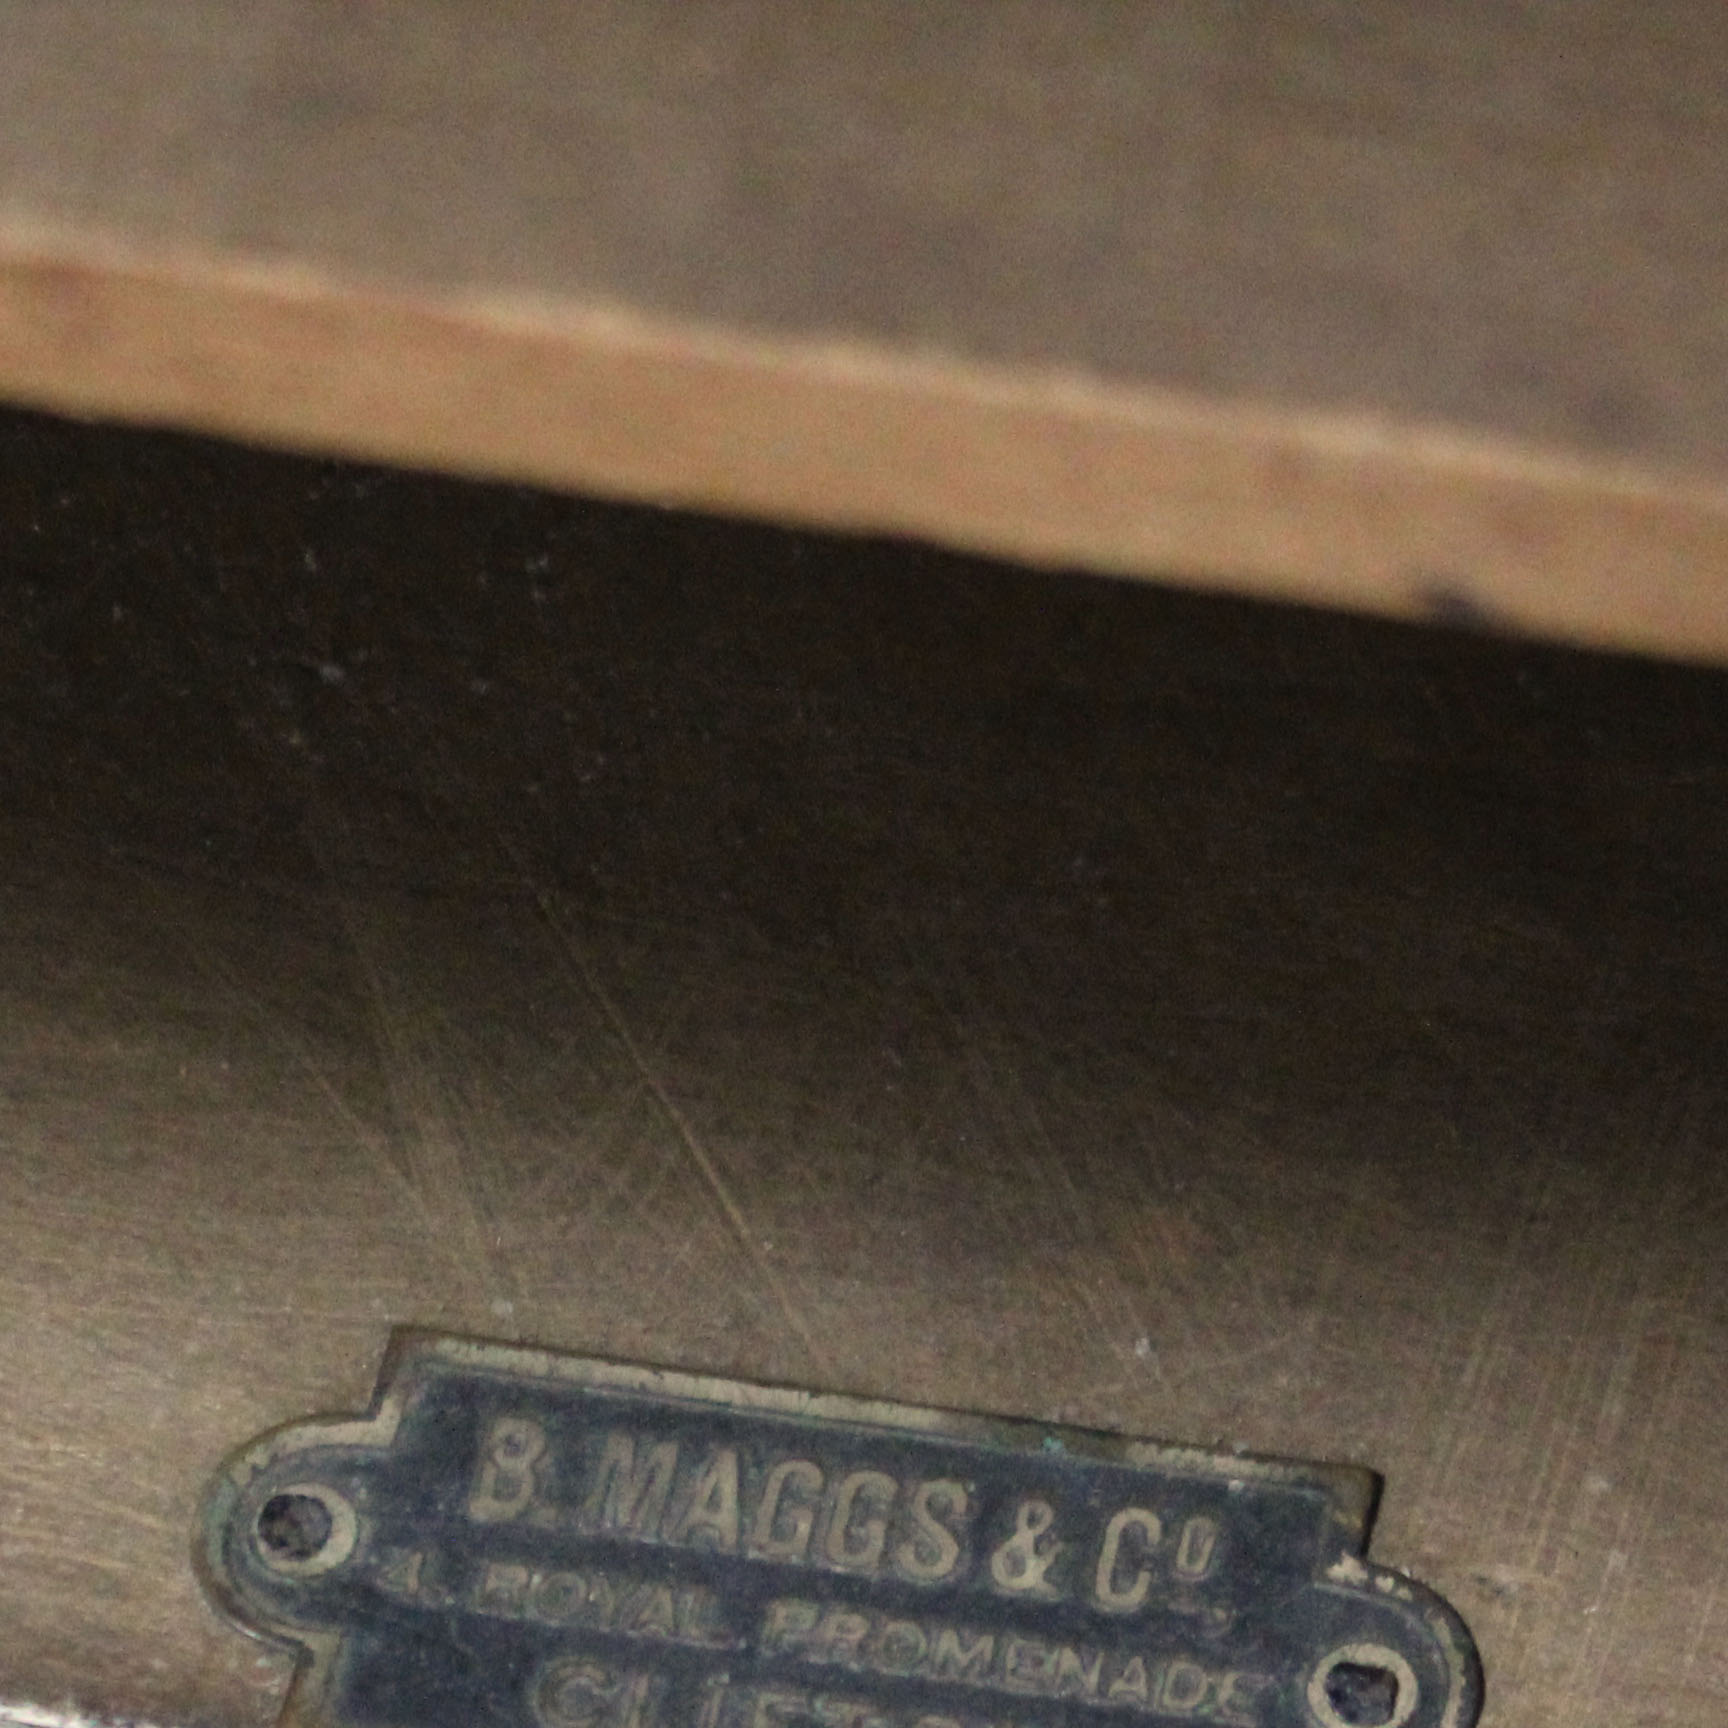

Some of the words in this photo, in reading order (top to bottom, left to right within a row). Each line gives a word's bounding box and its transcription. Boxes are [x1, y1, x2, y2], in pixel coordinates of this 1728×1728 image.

[583, 1432, 976, 1588] MAGGS
[988, 1500, 1058, 1598] &
[476, 1565, 740, 1648] ROYAL
